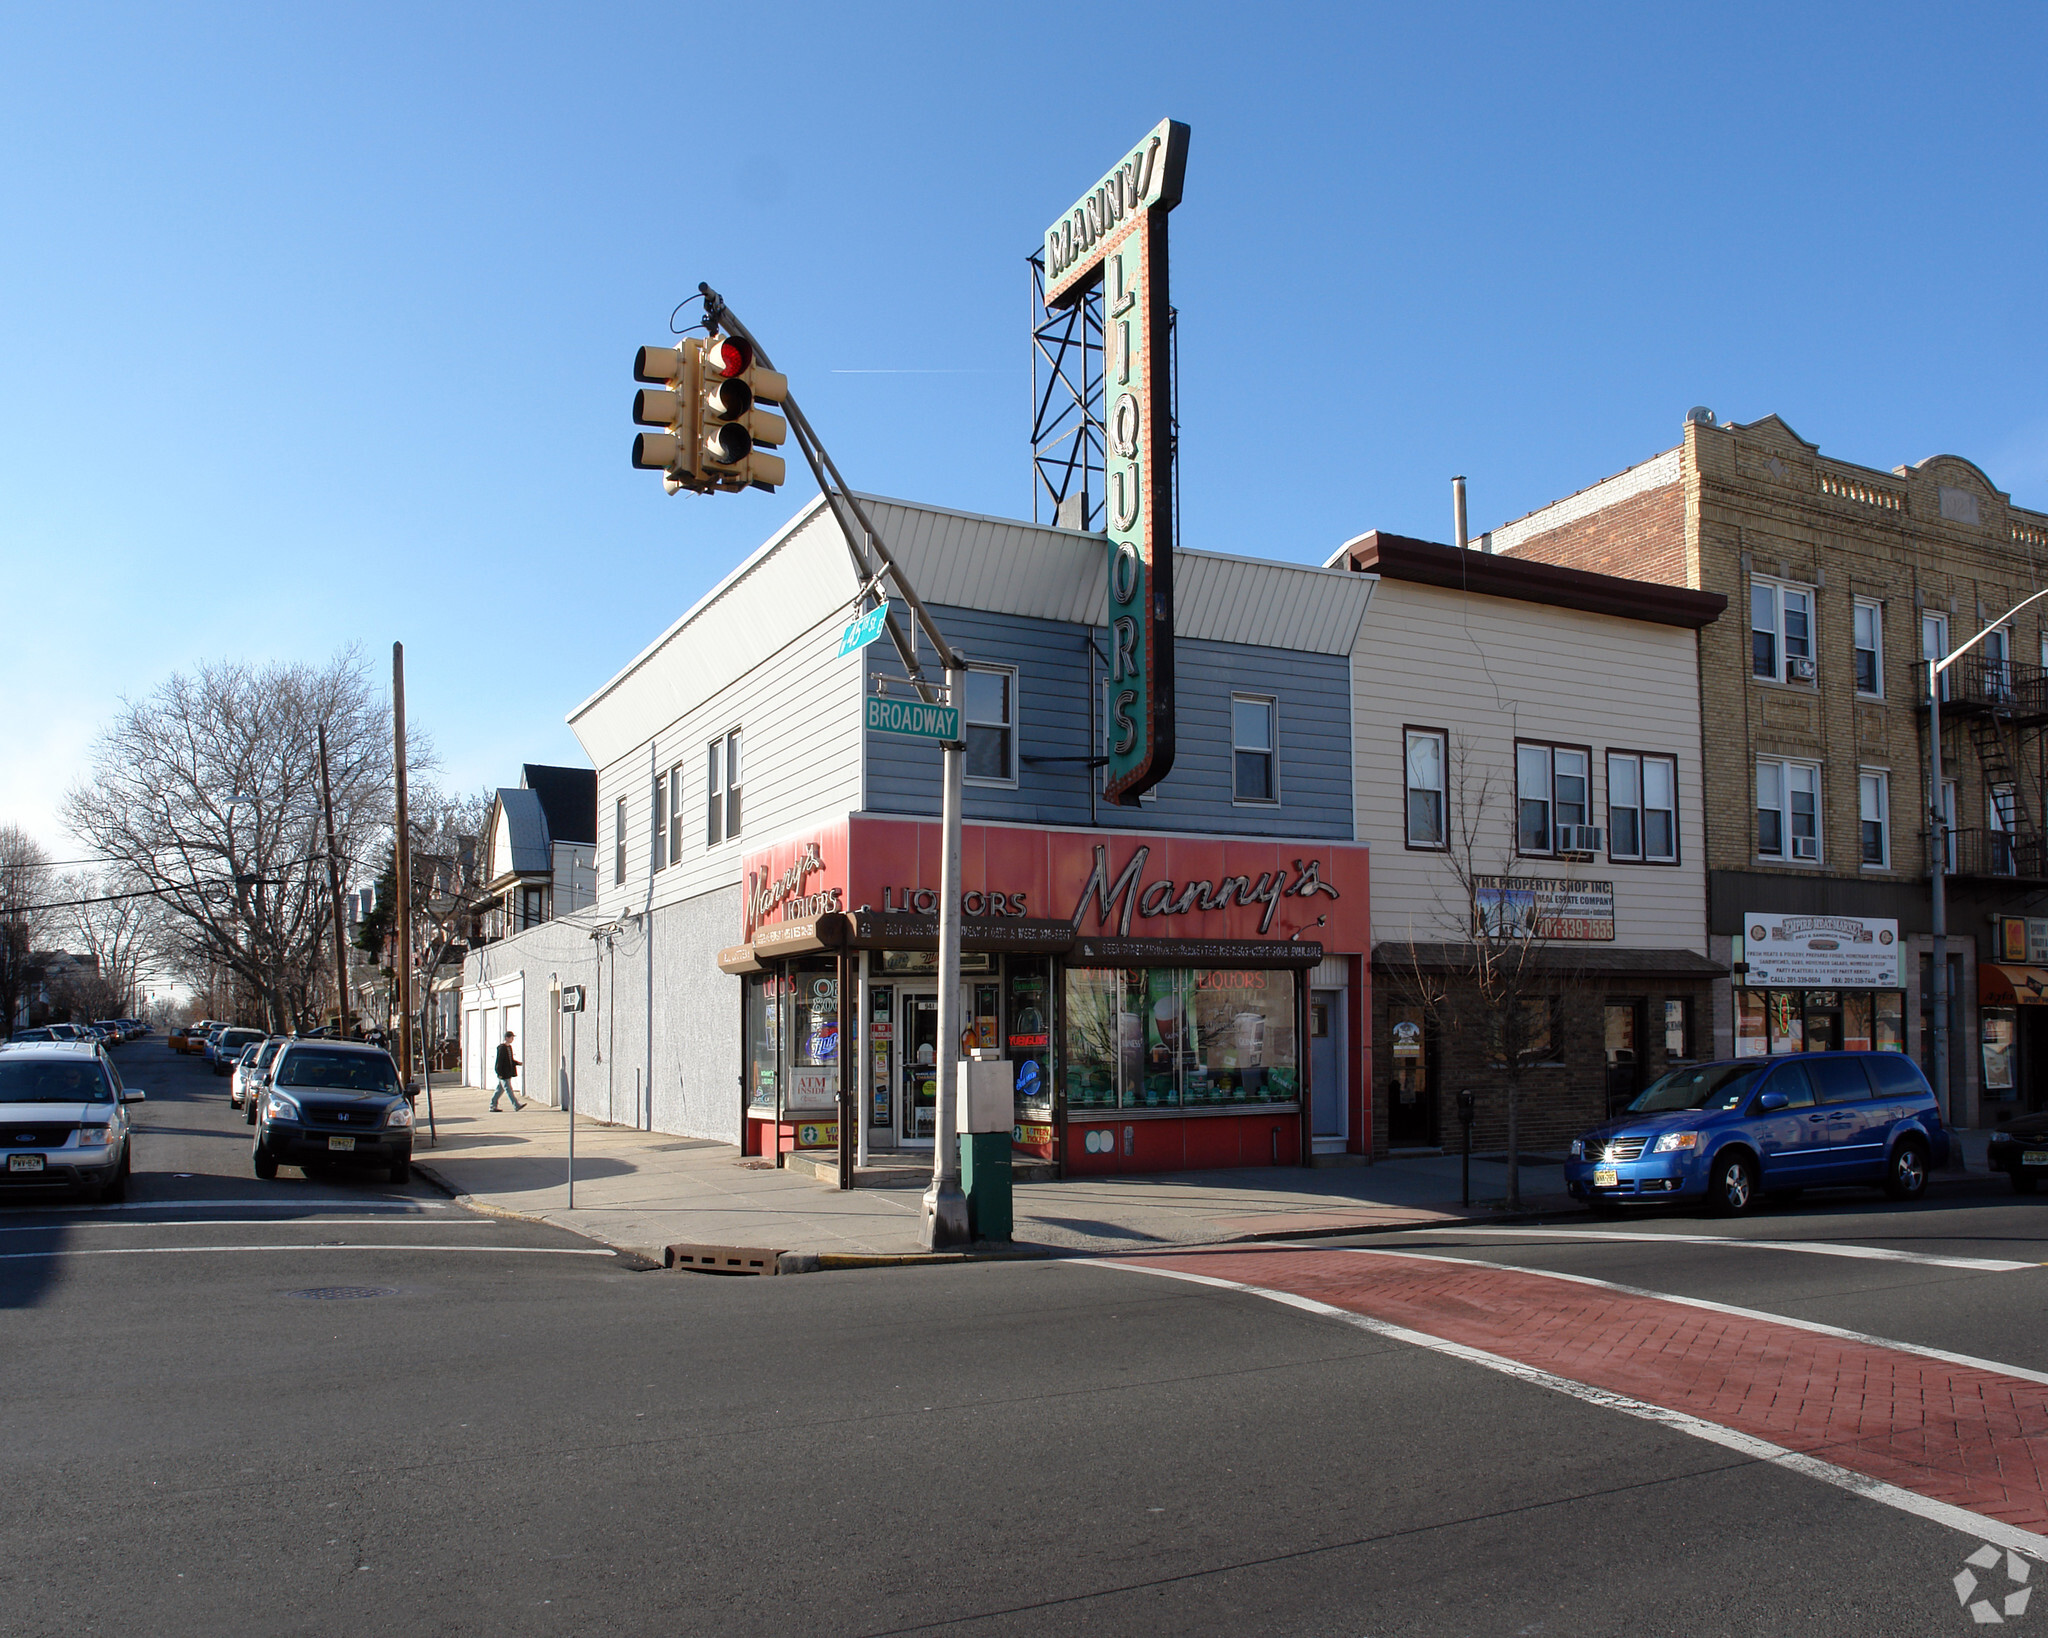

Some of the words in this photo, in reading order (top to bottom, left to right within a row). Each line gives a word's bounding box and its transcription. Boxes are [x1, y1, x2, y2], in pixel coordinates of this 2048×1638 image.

[1111, 254, 1141, 755] LIQUORS
[869, 702, 955, 736] BROADWAY
[1073, 845, 1340, 937] Manny's
[1476, 877, 1495, 888] THE
[1499, 879, 1556, 891] PROPERTY
[1560, 881, 1588, 892] SHOP
[882, 886, 1027, 918] LIQORS
[1555, 895, 1579, 905] ESTATE
[1580, 896, 1612, 906] COMPANY
[1538, 918, 1613, 938] 201-339-7555
[1199, 971, 1265, 990] LIQUORS
[800, 1077, 826, 1087] ATM
[798, 1087, 825, 1095] INSIDE
[1027, 1124, 1050, 1136] LOTTERY
[1027, 1134, 1048, 1145] TICKETS
